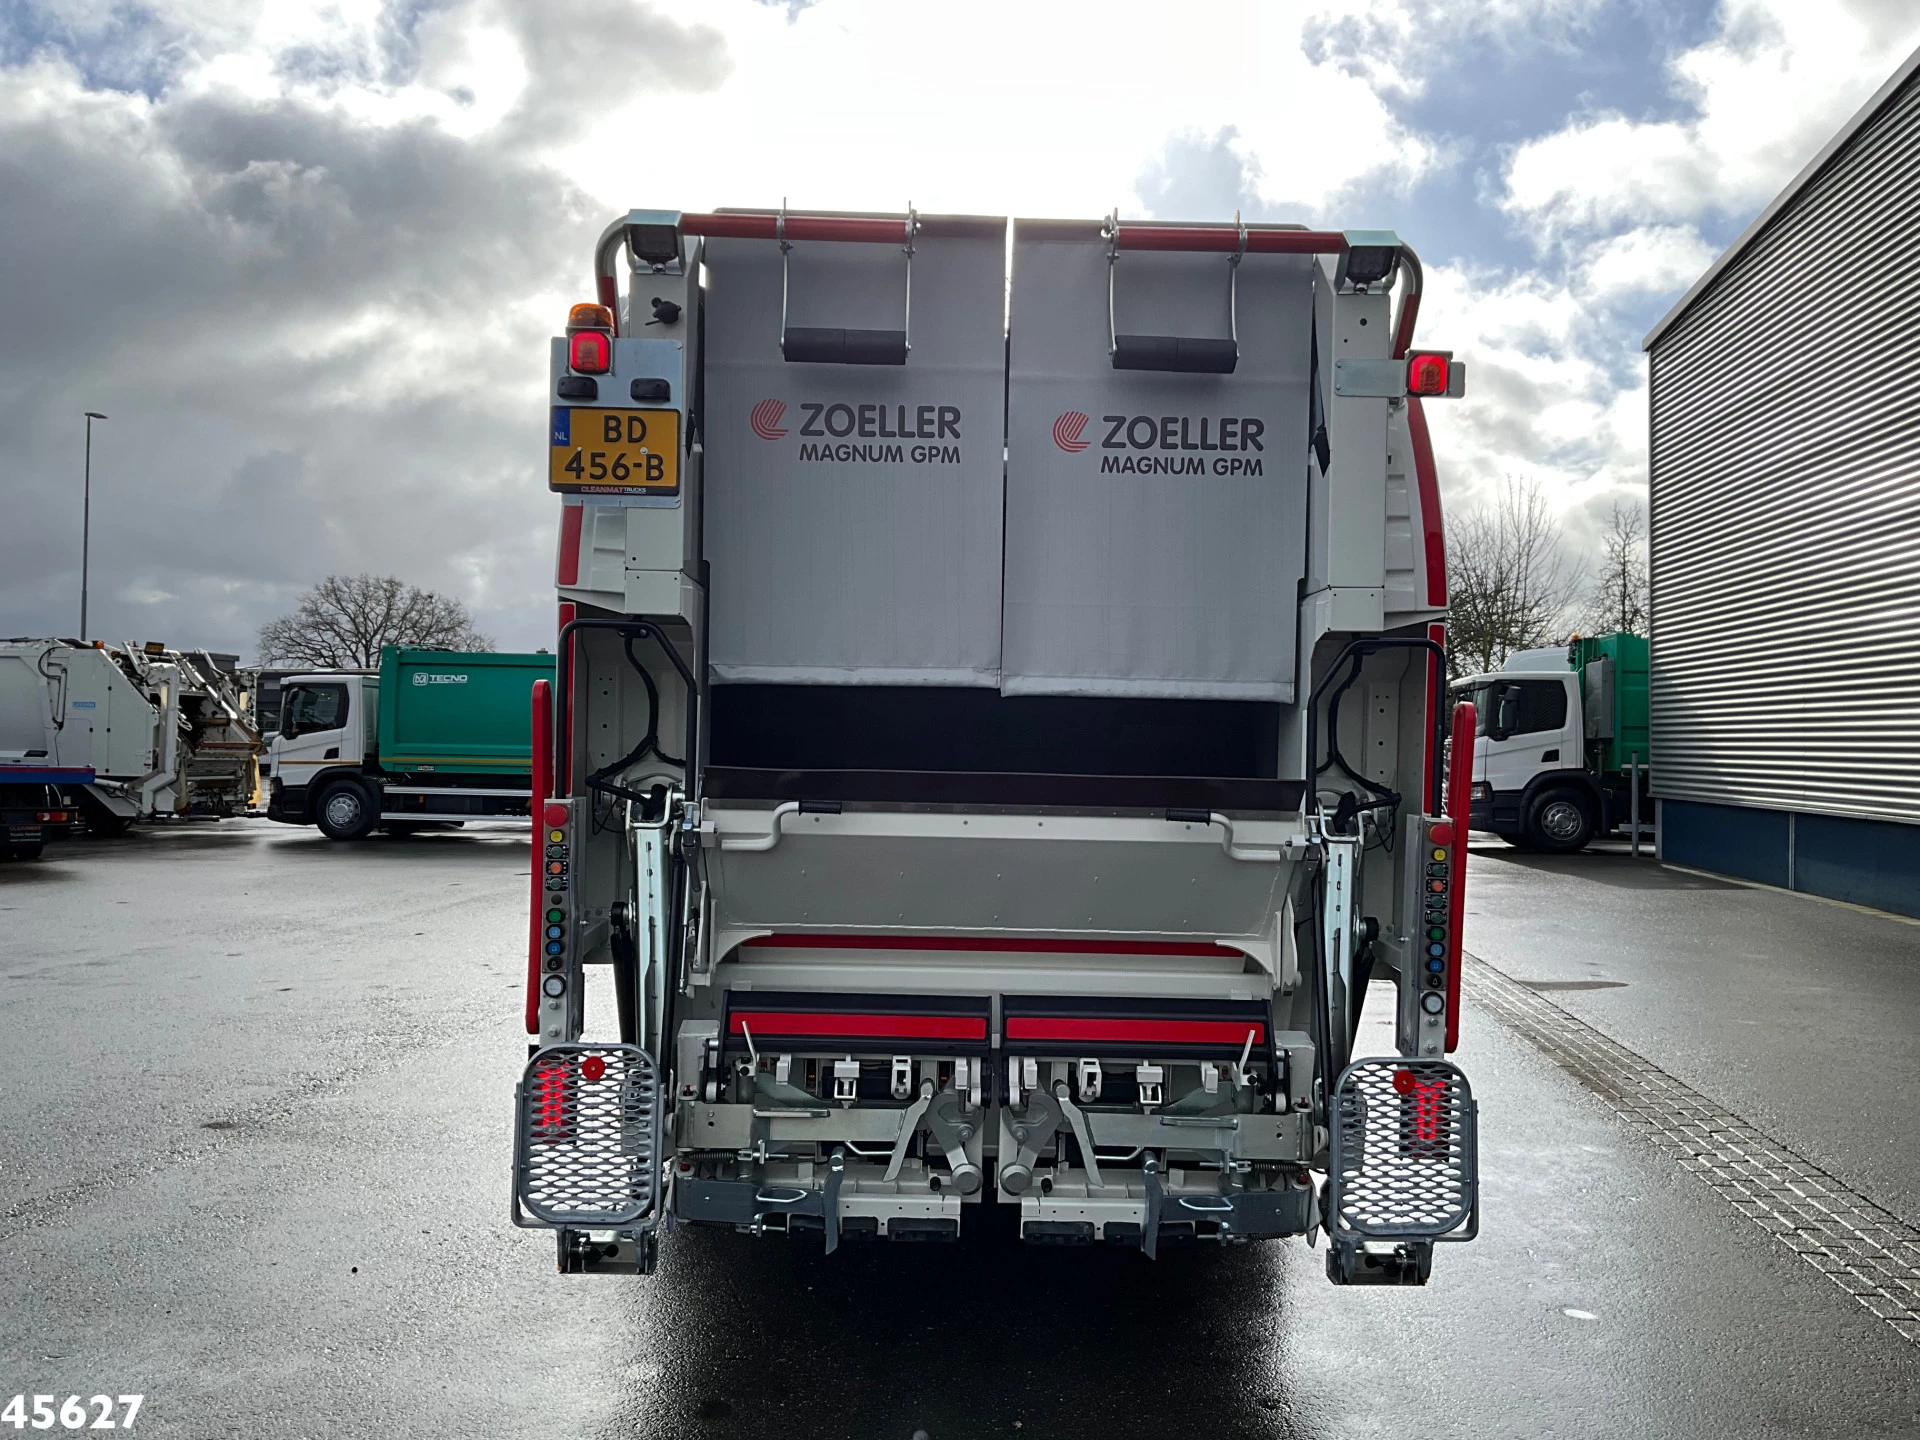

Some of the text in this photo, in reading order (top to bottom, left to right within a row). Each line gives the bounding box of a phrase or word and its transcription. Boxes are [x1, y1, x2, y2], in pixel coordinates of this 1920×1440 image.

[603, 415, 647, 443] BD
[799, 403, 961, 439] ZOELLER
[554, 432, 568, 440] NL
[1101, 416, 1265, 451] ZOELLER
[564, 448, 664, 481] 456-B
[799, 443, 961, 464] MAGNUM GPM
[1100, 455, 1264, 476] MAGNUM GPM
[429, 674, 468, 682] TECNO
